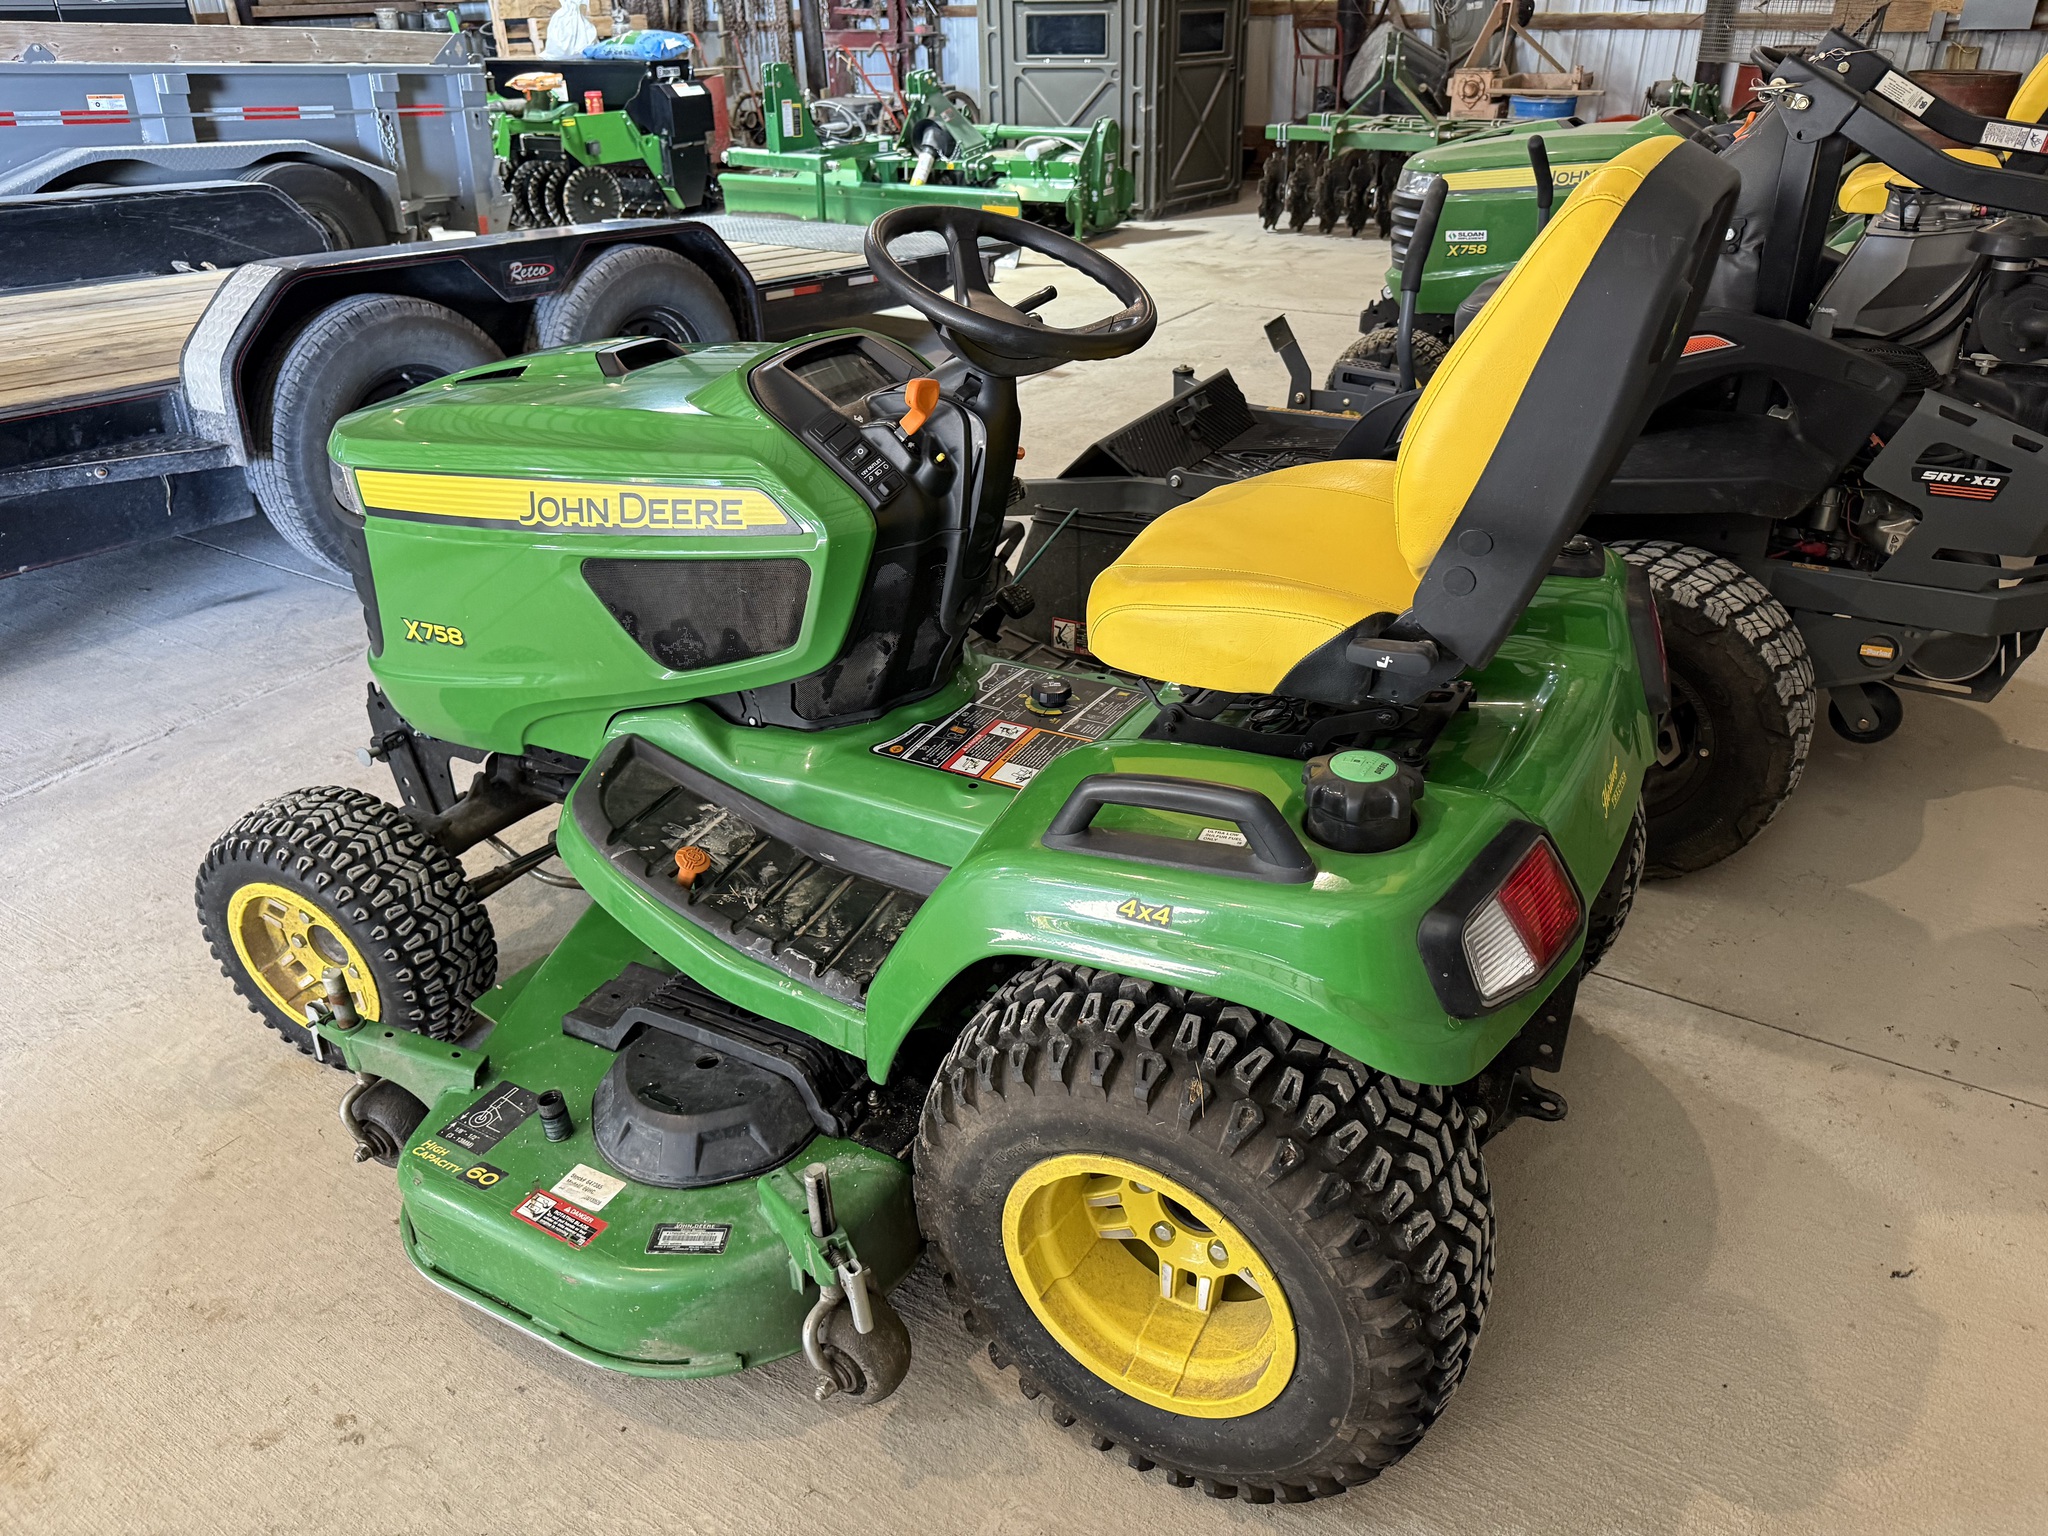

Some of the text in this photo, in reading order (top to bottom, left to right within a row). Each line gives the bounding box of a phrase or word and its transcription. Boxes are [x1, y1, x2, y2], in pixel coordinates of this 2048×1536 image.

[1446, 244, 1487, 257] X758
[509, 261, 548, 281] Retco
[1920, 470, 2001, 487] SRT-XD
[519, 490, 744, 527] JOHN DEERE
[401, 617, 465, 647] X758
[1118, 899, 1171, 926] 4x4
[420, 1139, 451, 1157] HIGH
[411, 1146, 464, 1174] CAPACITY
[466, 1166, 500, 1186] 60
[553, 1209, 591, 1231] ROTATING BLADE
[570, 1209, 595, 1224] DANGER
[673, 1222, 694, 1230] JOHN
